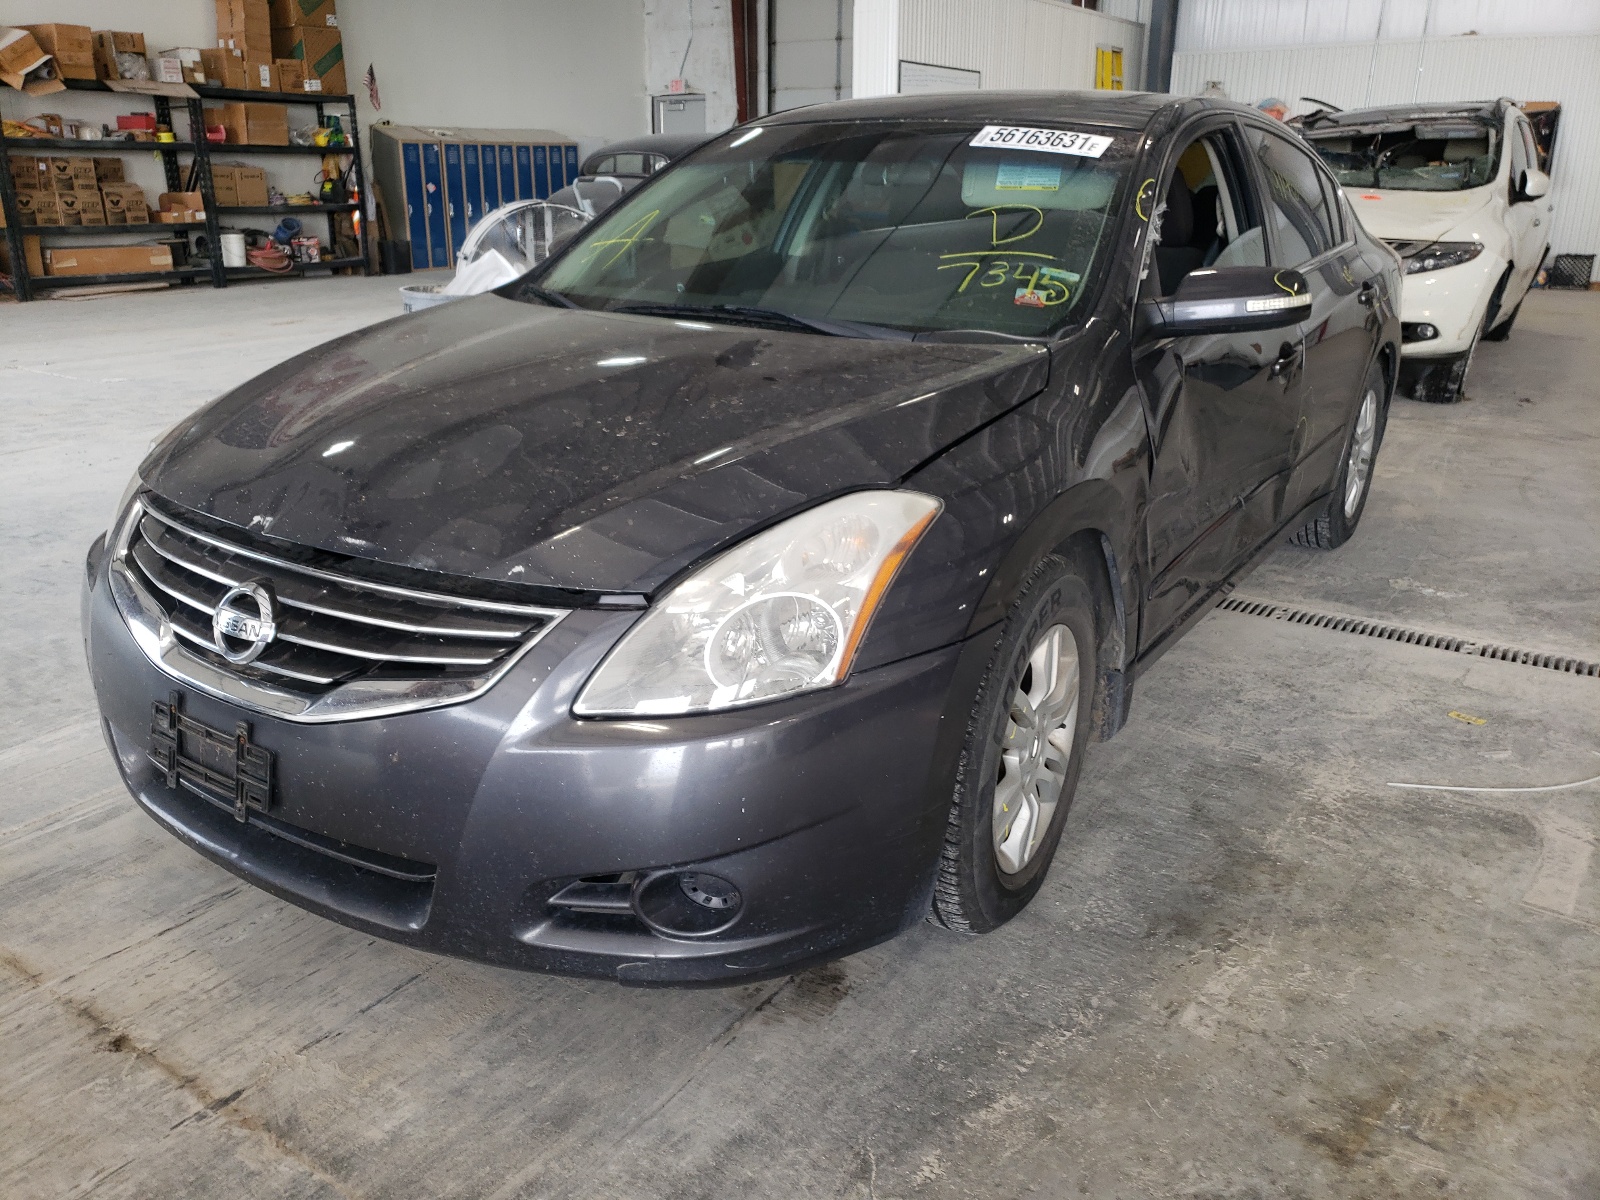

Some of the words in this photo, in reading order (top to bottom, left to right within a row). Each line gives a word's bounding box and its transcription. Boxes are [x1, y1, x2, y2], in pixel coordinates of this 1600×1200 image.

[989, 127, 1093, 151] 56163631
[581, 208, 661, 271] A
[965, 203, 1044, 247] D
[937, 261, 1069, 305] 7345
[992, 587, 1062, 747] COOPER
